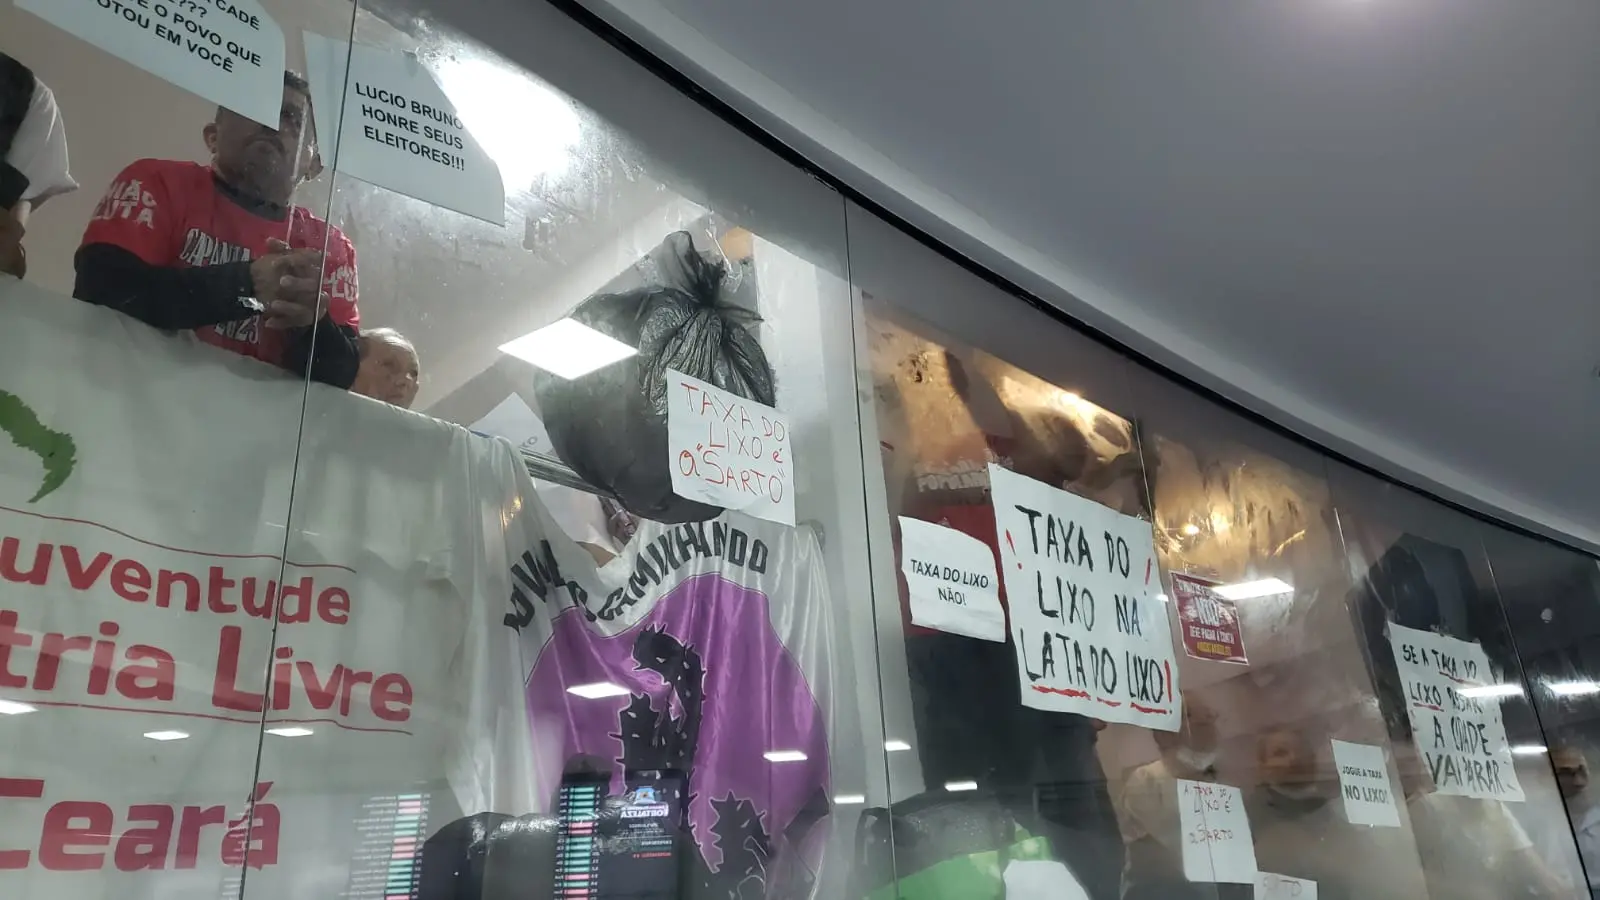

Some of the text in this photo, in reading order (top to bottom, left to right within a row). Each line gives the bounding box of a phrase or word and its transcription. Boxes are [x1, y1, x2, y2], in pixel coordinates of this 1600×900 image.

[97, 0, 234, 73] OTOU EM VOCÊ
[154, 4, 168, 18] O
[173, 13, 222, 46] POVO
[226, 41, 262, 67] QUE
[216, 0, 260, 31] CADÊ
[356, 82, 464, 130] LUCIO BRUNO
[362, 104, 464, 150] HONRE SEUS
[364, 125, 465, 171] ELEITORES!!!
[681, 382, 786, 442] TAXA DO
[709, 421, 763, 460] LIXO
[1014, 504, 1094, 573] TAXA
[1104, 529, 1131, 579] DO
[0, 536, 352, 625] uventude
[910, 558, 989, 589] TAXA DO LIXO
[937, 586, 967, 606] NÃO!
[1037, 569, 1142, 637] LIXO NA
[0, 609, 414, 723] tria Livre
[1020, 627, 1088, 688] LATA
[1089, 643, 1118, 695] DO
[1402, 643, 1419, 665] SE
[1422, 647, 1430, 666] A
[1408, 680, 1442, 707] LIXO
[1433, 715, 1446, 749] A
[1344, 784, 1360, 800] NO
